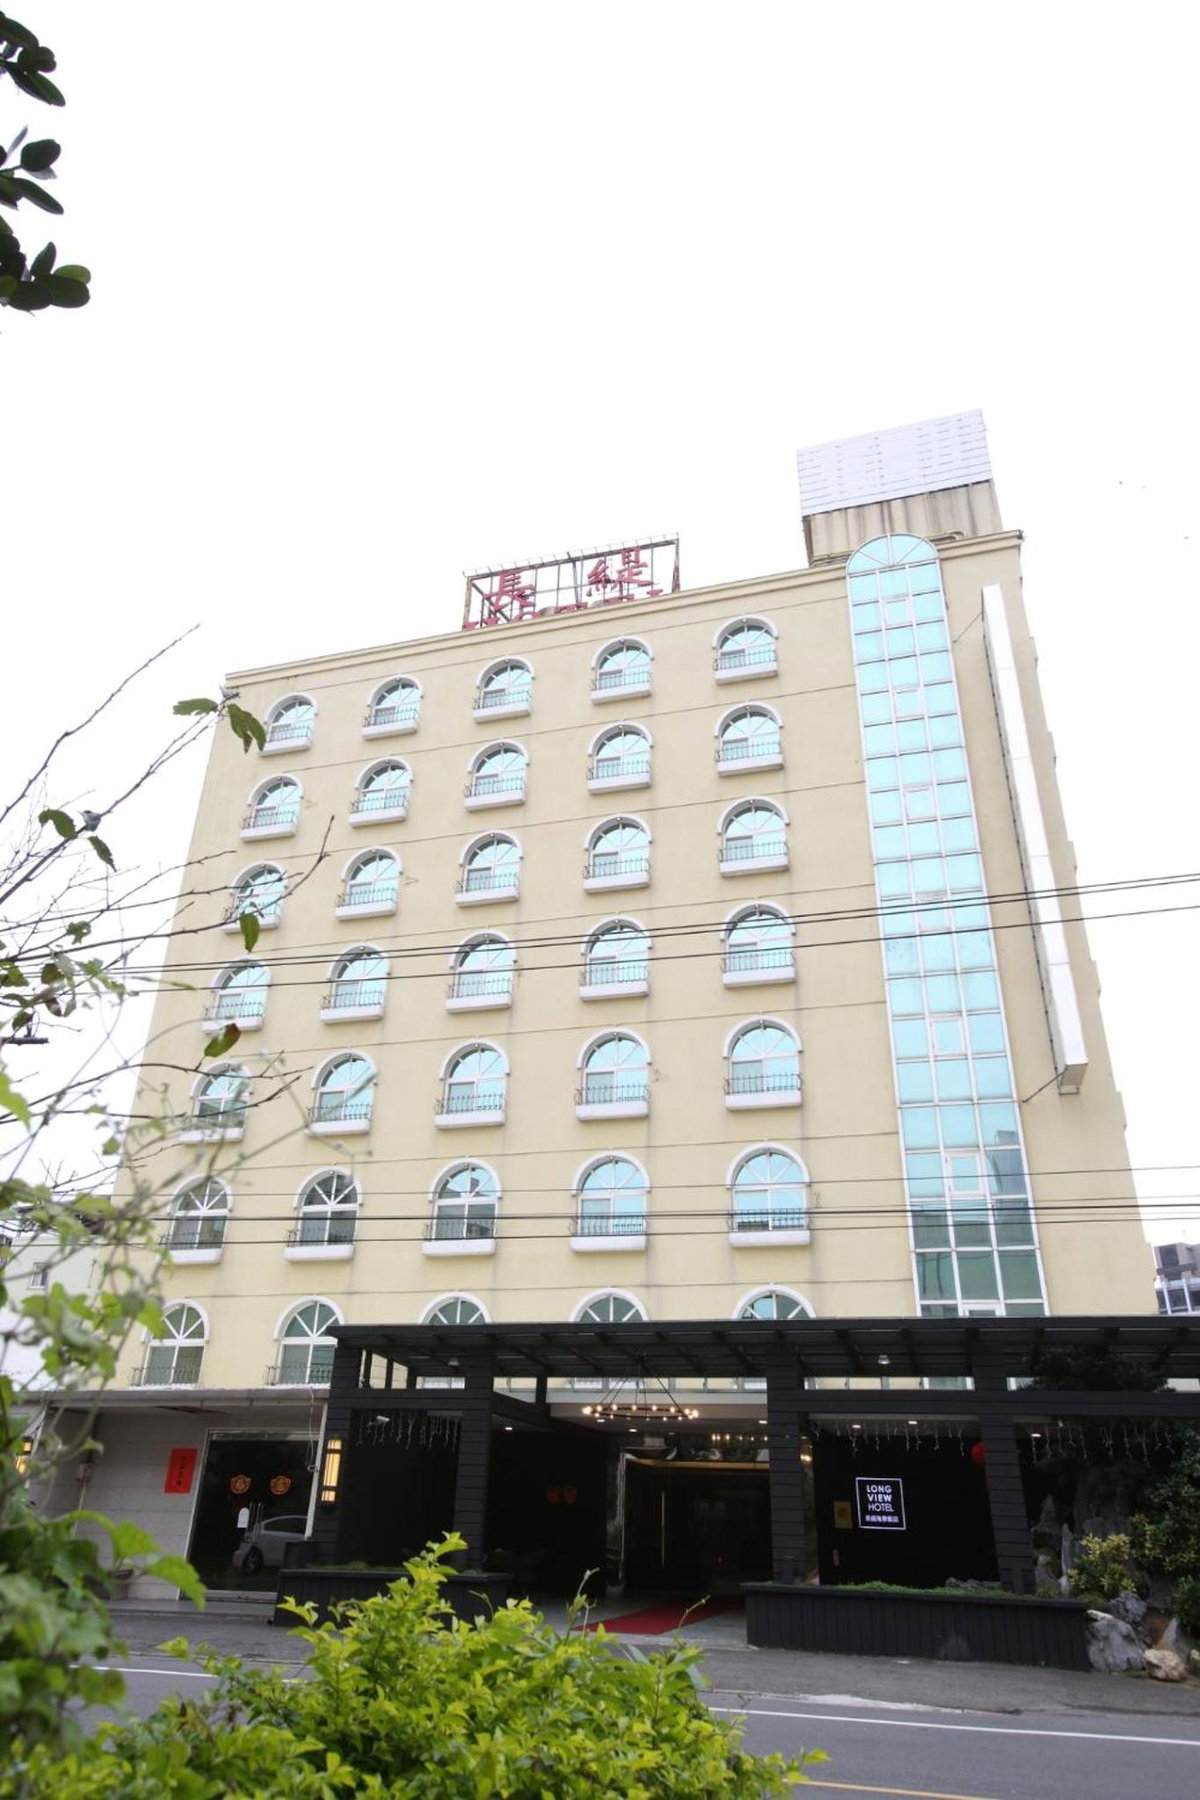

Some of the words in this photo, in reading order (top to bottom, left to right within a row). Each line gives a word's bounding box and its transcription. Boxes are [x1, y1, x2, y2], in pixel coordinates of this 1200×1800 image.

[866, 1485, 892, 1493] LONG
[867, 1494, 892, 1502] VIEW
[868, 1503, 894, 1512] HOTEL
